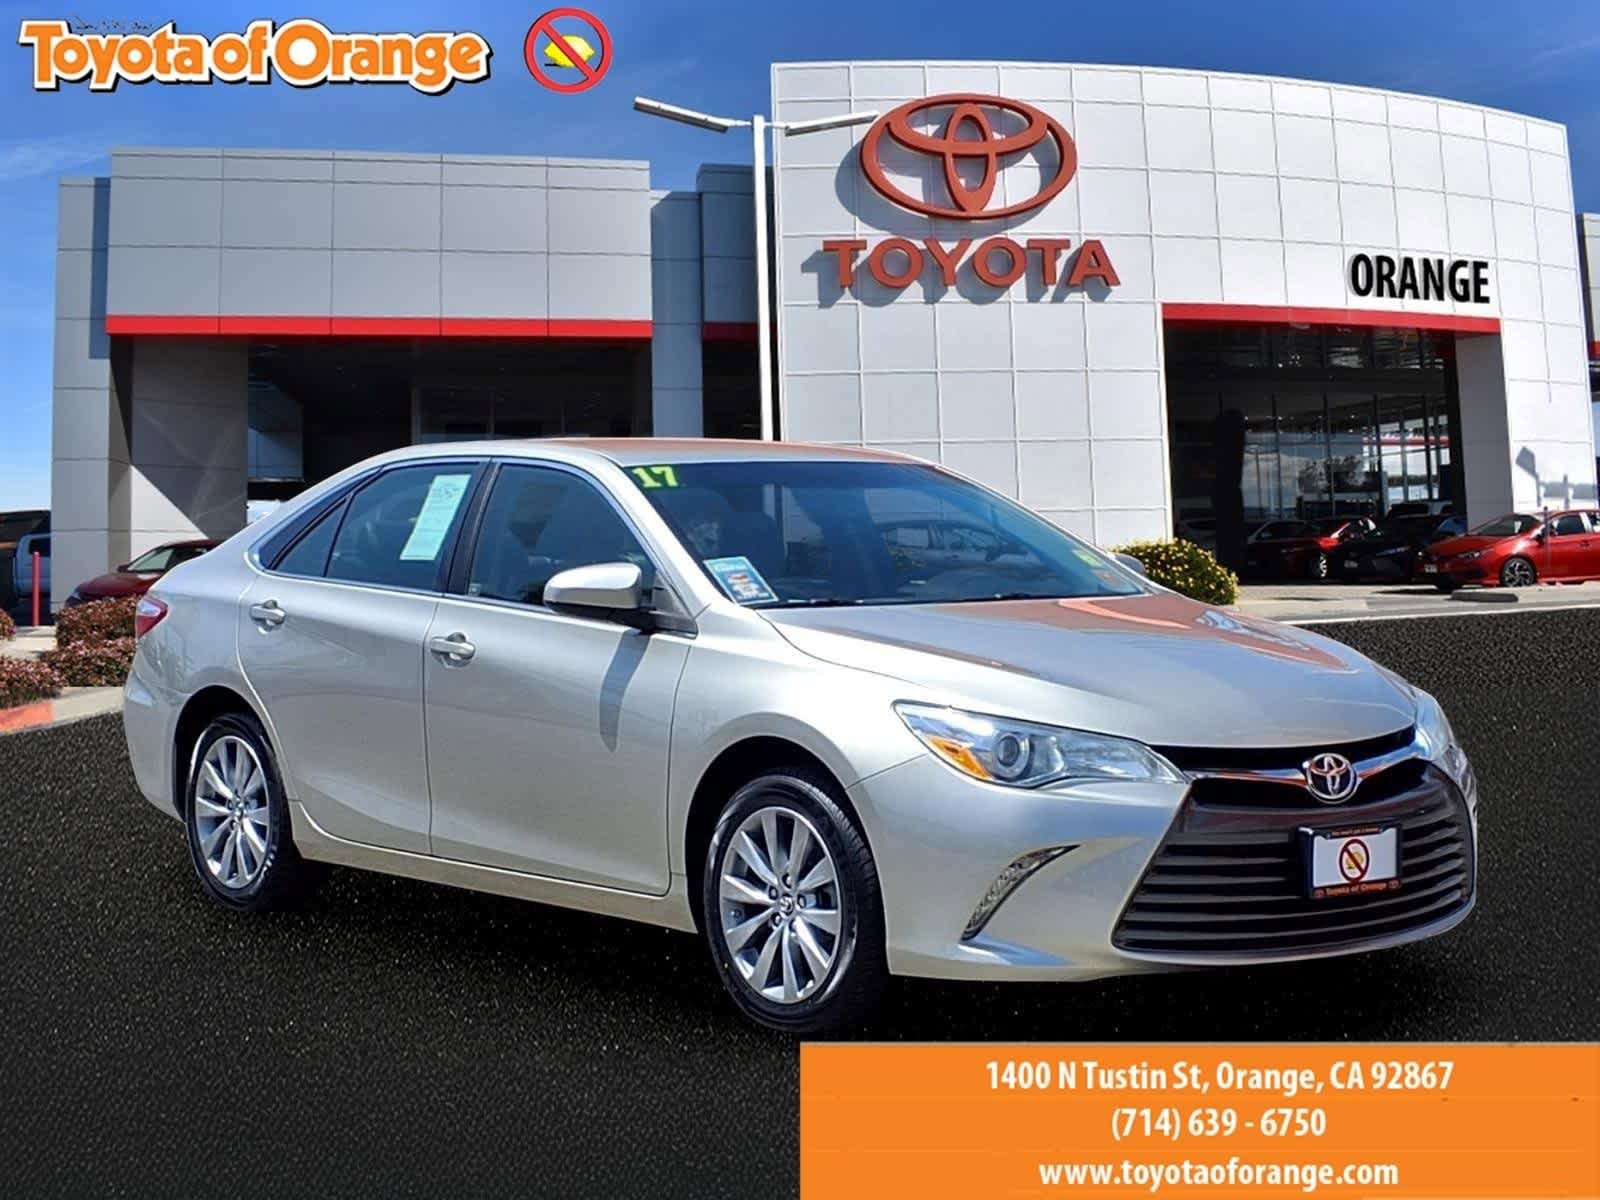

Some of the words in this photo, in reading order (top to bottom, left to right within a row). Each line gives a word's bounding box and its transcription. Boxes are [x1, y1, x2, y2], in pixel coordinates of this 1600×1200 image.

[822, 238, 1120, 289] TOYOTA
[1348, 253, 1491, 304] ORANGE
[632, 465, 679, 489] 17
